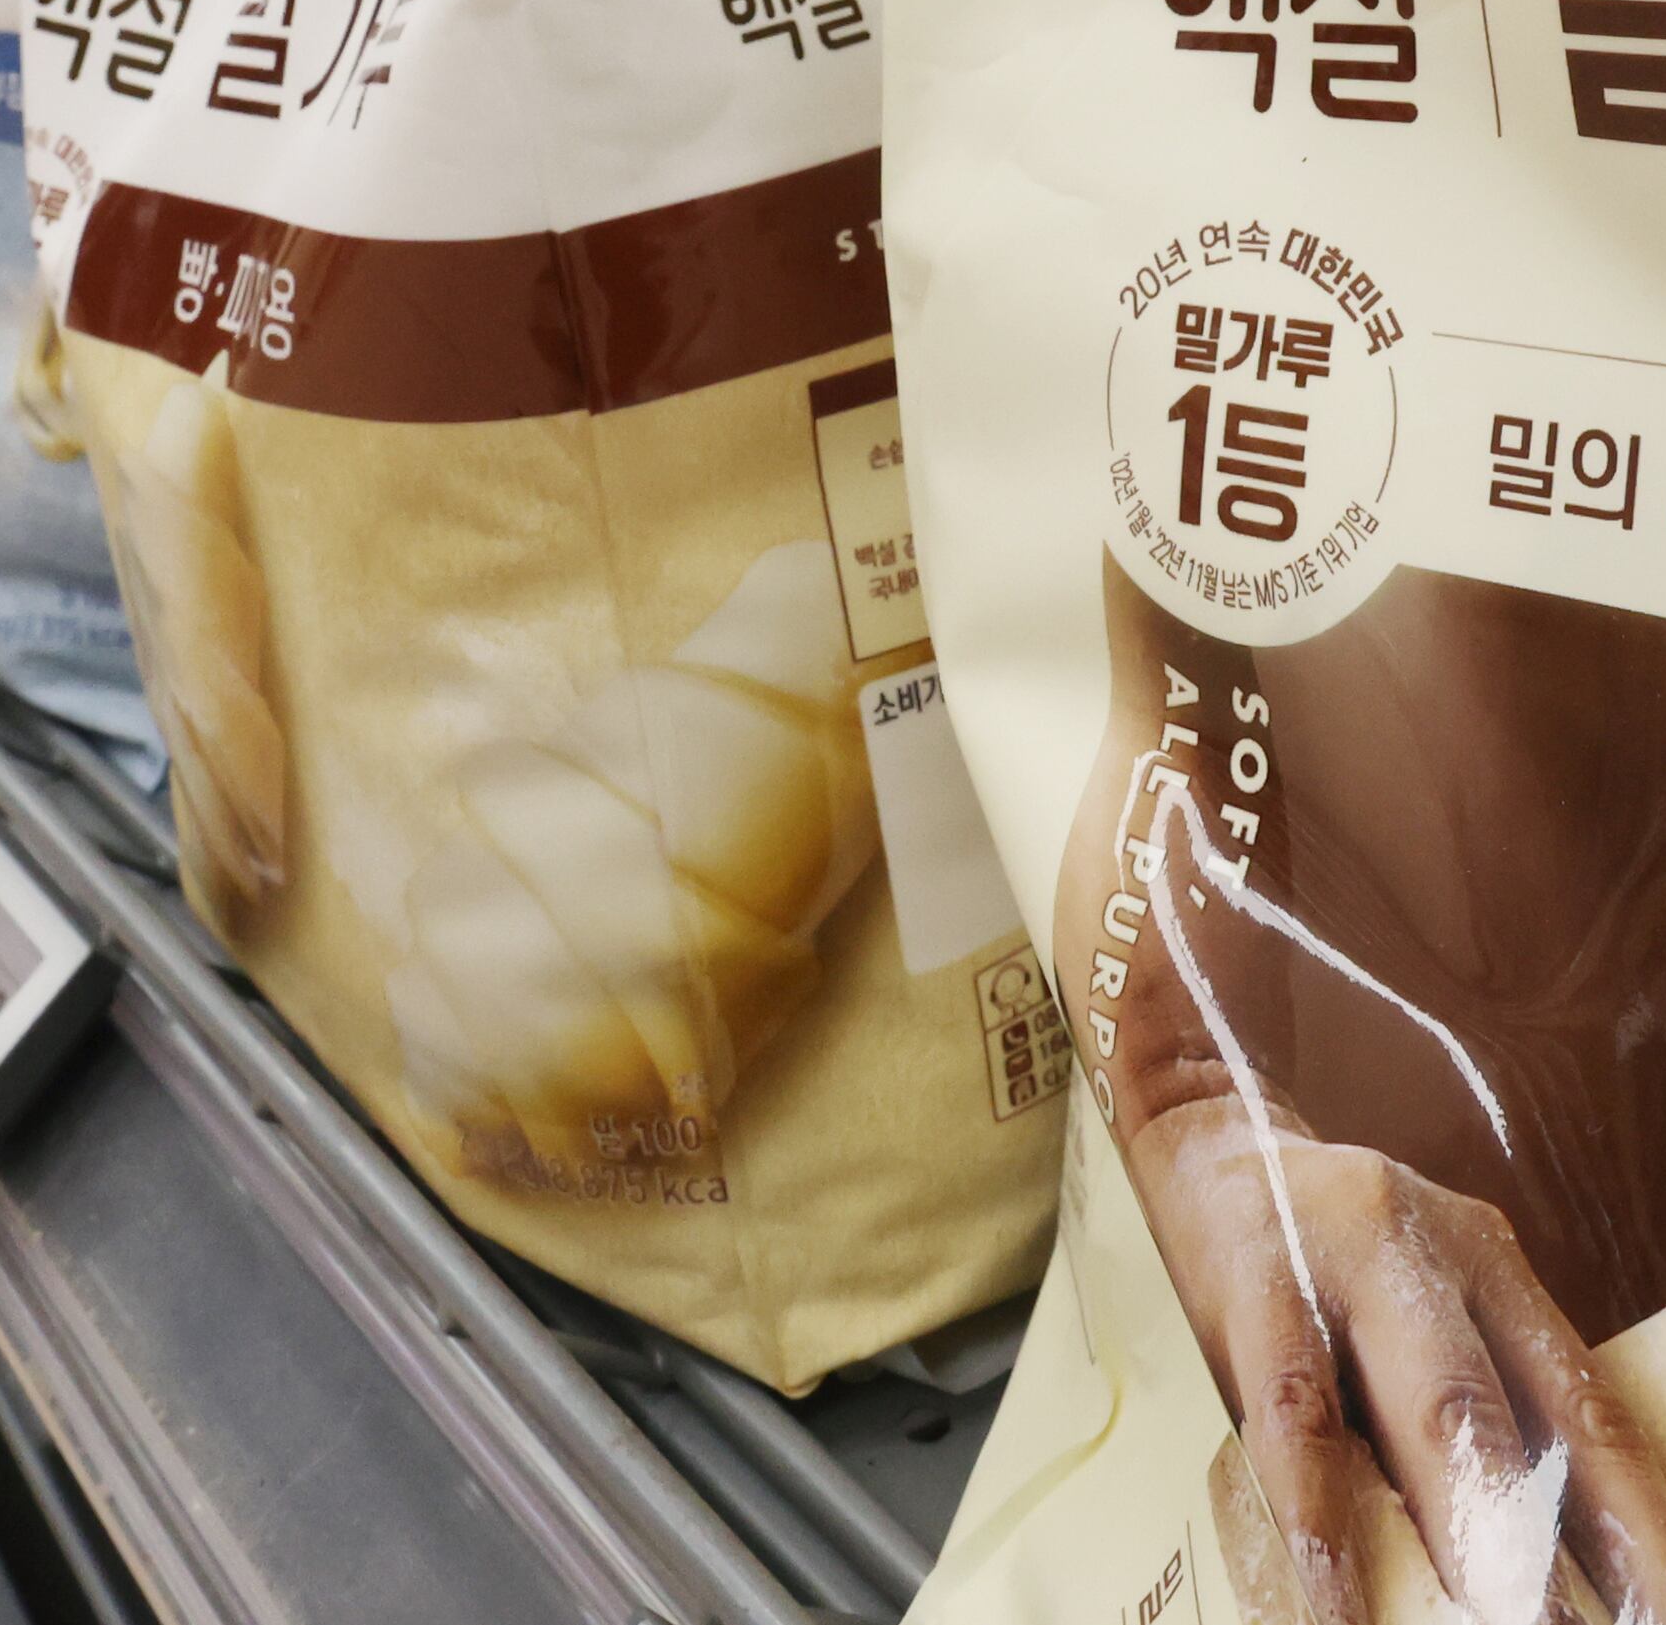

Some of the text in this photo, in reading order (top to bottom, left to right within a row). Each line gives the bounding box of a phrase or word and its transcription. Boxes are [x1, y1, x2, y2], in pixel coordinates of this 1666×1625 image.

[1119, 220, 1405, 358] 20년 연속 대한민국
[1174, 303, 1334, 389] 밀가루
[1168, 383, 1309, 543] 1등
[1488, 413, 1642, 531] 밀의
[1284, 552, 1325, 600] 기준
[1315, 531, 1352, 576] 1위
[1334, 499, 1380, 551] 기업
[874, 674, 945, 727] 소비기
[1087, 662, 1200, 1127] ALL PURPO
[635, 1114, 703, 1157] 100
